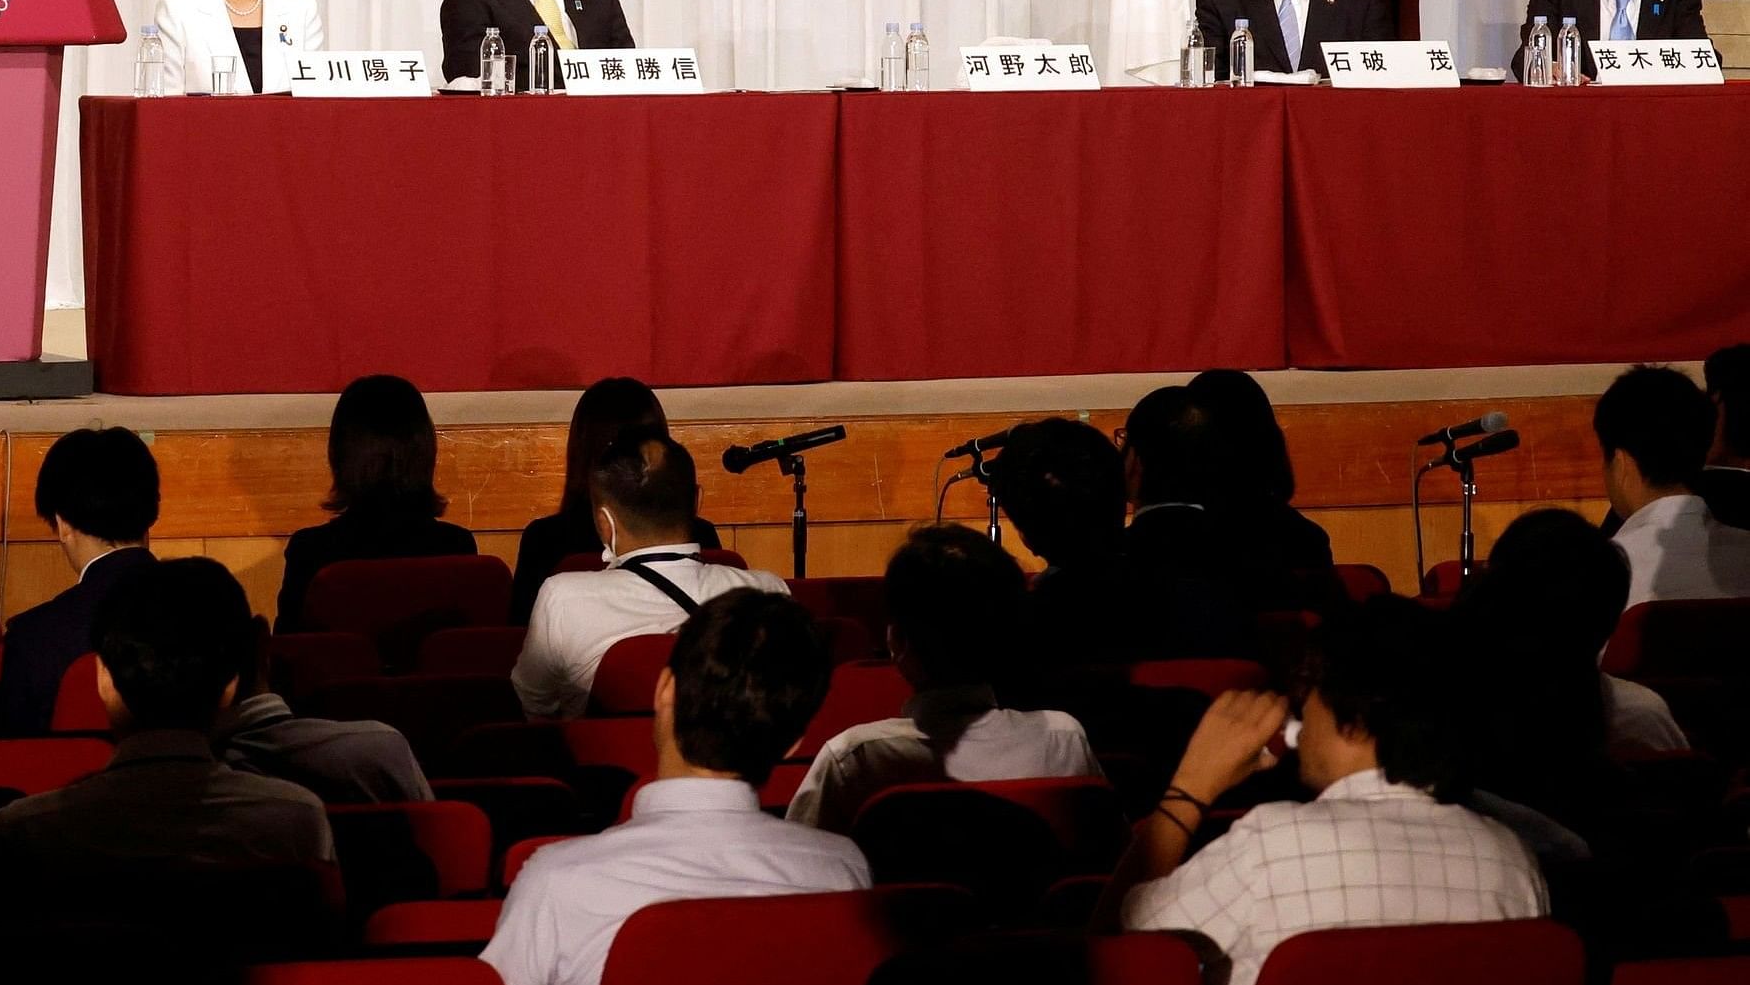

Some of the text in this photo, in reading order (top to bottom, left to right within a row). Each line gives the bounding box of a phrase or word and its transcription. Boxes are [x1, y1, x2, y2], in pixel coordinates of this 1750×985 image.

[563, 57, 697, 81] 加藤勝信
[966, 53, 1094, 76] 河野太郎
[1595, 46, 1718, 70] 茂木敏充
[291, 59, 425, 82] 上川陽子
